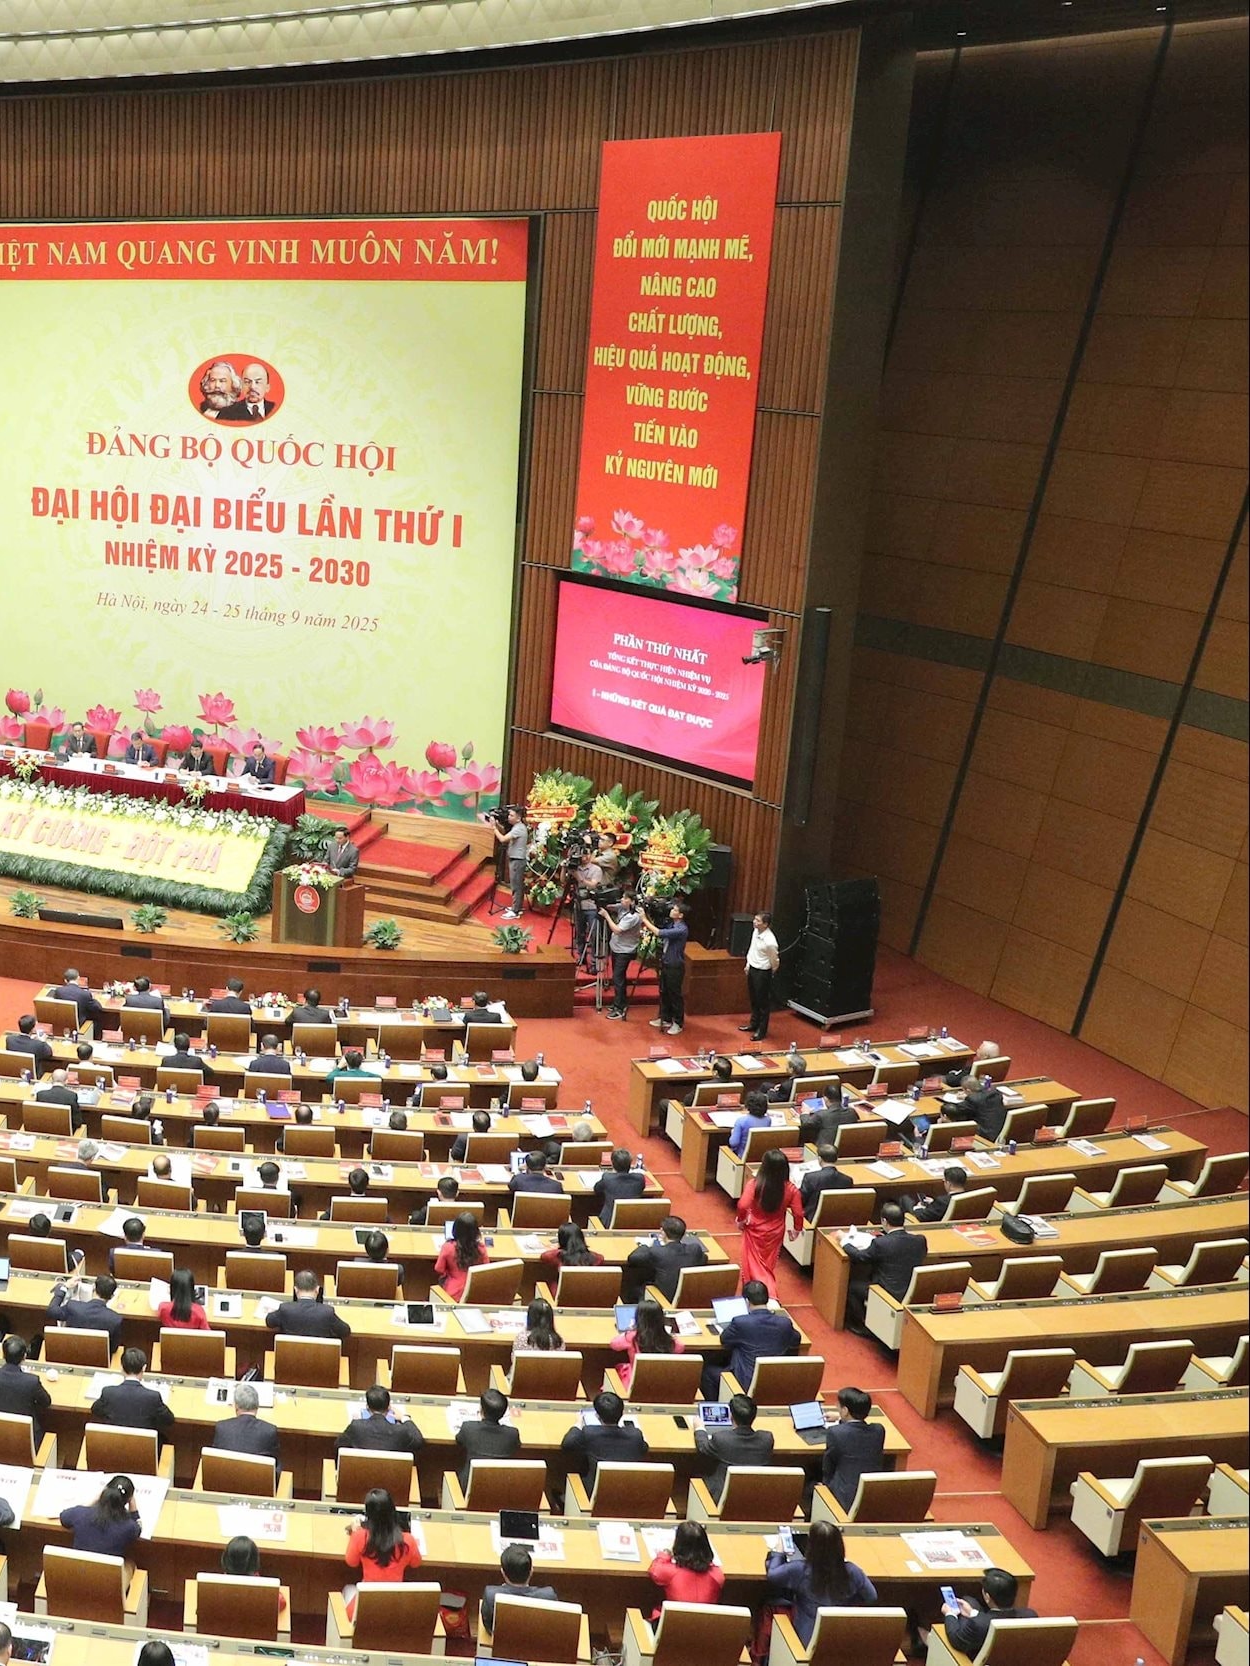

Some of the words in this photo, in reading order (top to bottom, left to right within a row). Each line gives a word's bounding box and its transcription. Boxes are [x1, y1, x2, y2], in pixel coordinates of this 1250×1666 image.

[646, 192, 687, 223] QUỐC
[690, 194, 719, 225] HỘI
[47, 241, 108, 266] NAM
[116, 238, 217, 269] QUANG
[226, 238, 300, 265] VINH
[309, 230, 404, 265] MUÔN
[412, 230, 500, 266] NĂM!
[612, 230, 638, 259] ĐỔI
[640, 234, 669, 260] MỚI
[672, 237, 720, 264] MẠNH
[723, 234, 754, 263] MẼ,
[640, 271, 683, 297] NÂNG
[685, 277, 717, 298] CAO
[628, 307, 666, 334] CHẤT
[668, 315, 723, 340] LƯỢNG,
[593, 343, 626, 371] HIỆU
[628, 344, 658, 371] QUẢ
[661, 352, 701, 378] HOẠT
[703, 351, 751, 380] ĐỘNG,
[626, 382, 664, 408] VỮNG
[667, 385, 709, 413] BƯỚC
[86, 425, 171, 459] ĐẢNG
[179, 433, 223, 468] BỘ
[230, 434, 325, 470] QUỐC
[333, 442, 398, 478] HỘI
[633, 418, 665, 445] TIẾN
[669, 423, 698, 449] VÀO
[604, 450, 624, 475] KỶ
[626, 458, 685, 485] NGUYÊN
[688, 464, 719, 489] MỚI
[31, 486, 80, 525] ĐẠI
[90, 485, 140, 529] HỘI
[149, 493, 202, 534] ĐẠI
[212, 487, 286, 534] BIỂU
[297, 493, 362, 541] LẦN
[374, 504, 445, 546] THỨ
[452, 514, 463, 548] I
[104, 538, 180, 574] NHIỆM
[187, 542, 217, 573] KỲ
[225, 550, 284, 580] 2025
[308, 556, 371, 588] 2030
[96, 592, 117, 607] Hà
[120, 593, 149, 612] Nội,
[153, 598, 188, 617] ngày
[191, 600, 209, 616] 24
[223, 602, 241, 619] 25
[245, 605, 287, 627] tháng
[291, 609, 301, 624] 9
[304, 612, 337, 629] năm
[341, 614, 380, 633] 2025
[613, 633, 645, 650] PHẦN
[646, 640, 672, 657] THỨ
[673, 646, 709, 665] NHẤT
[123, 831, 175, 869] ĐỘT
[170, 839, 226, 874] PHÁ
